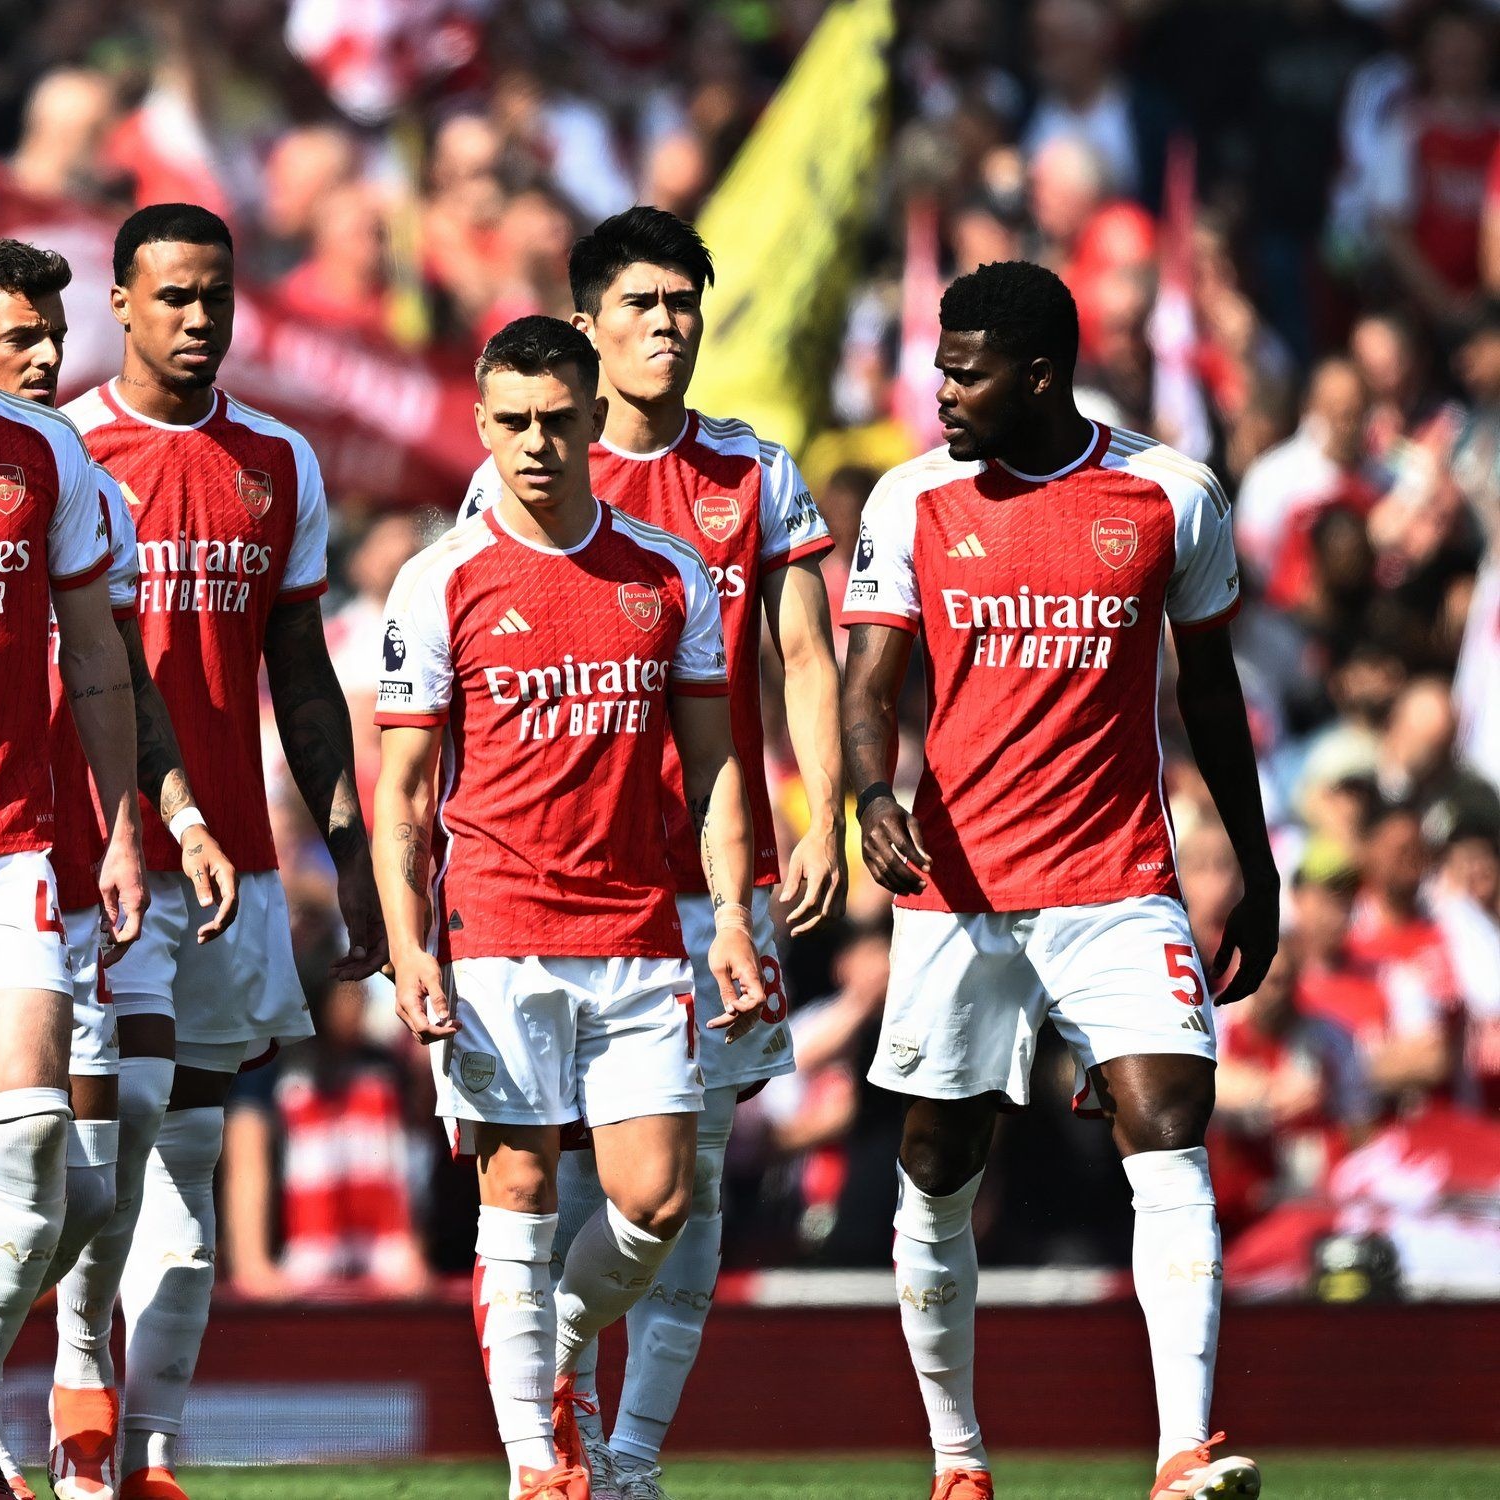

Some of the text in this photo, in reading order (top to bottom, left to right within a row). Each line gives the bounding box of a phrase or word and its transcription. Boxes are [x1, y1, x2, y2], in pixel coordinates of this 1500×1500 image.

[702, 504, 733, 513] Arsenal
[1099, 527, 1132, 536] Arsenal
[136, 530, 272, 575] mirates
[140, 578, 250, 614] FLY BETTER
[625, 590, 656, 600] Arsenal
[941, 585, 1140, 630] Emirates
[973, 634, 1113, 669] FLY BETTER
[484, 653, 669, 705] Emirates
[519, 700, 651, 741] FLY BETTER
[760, 955, 789, 1025] 8
[1164, 943, 1204, 1007] 5
[901, 1281, 958, 1312] AFC
